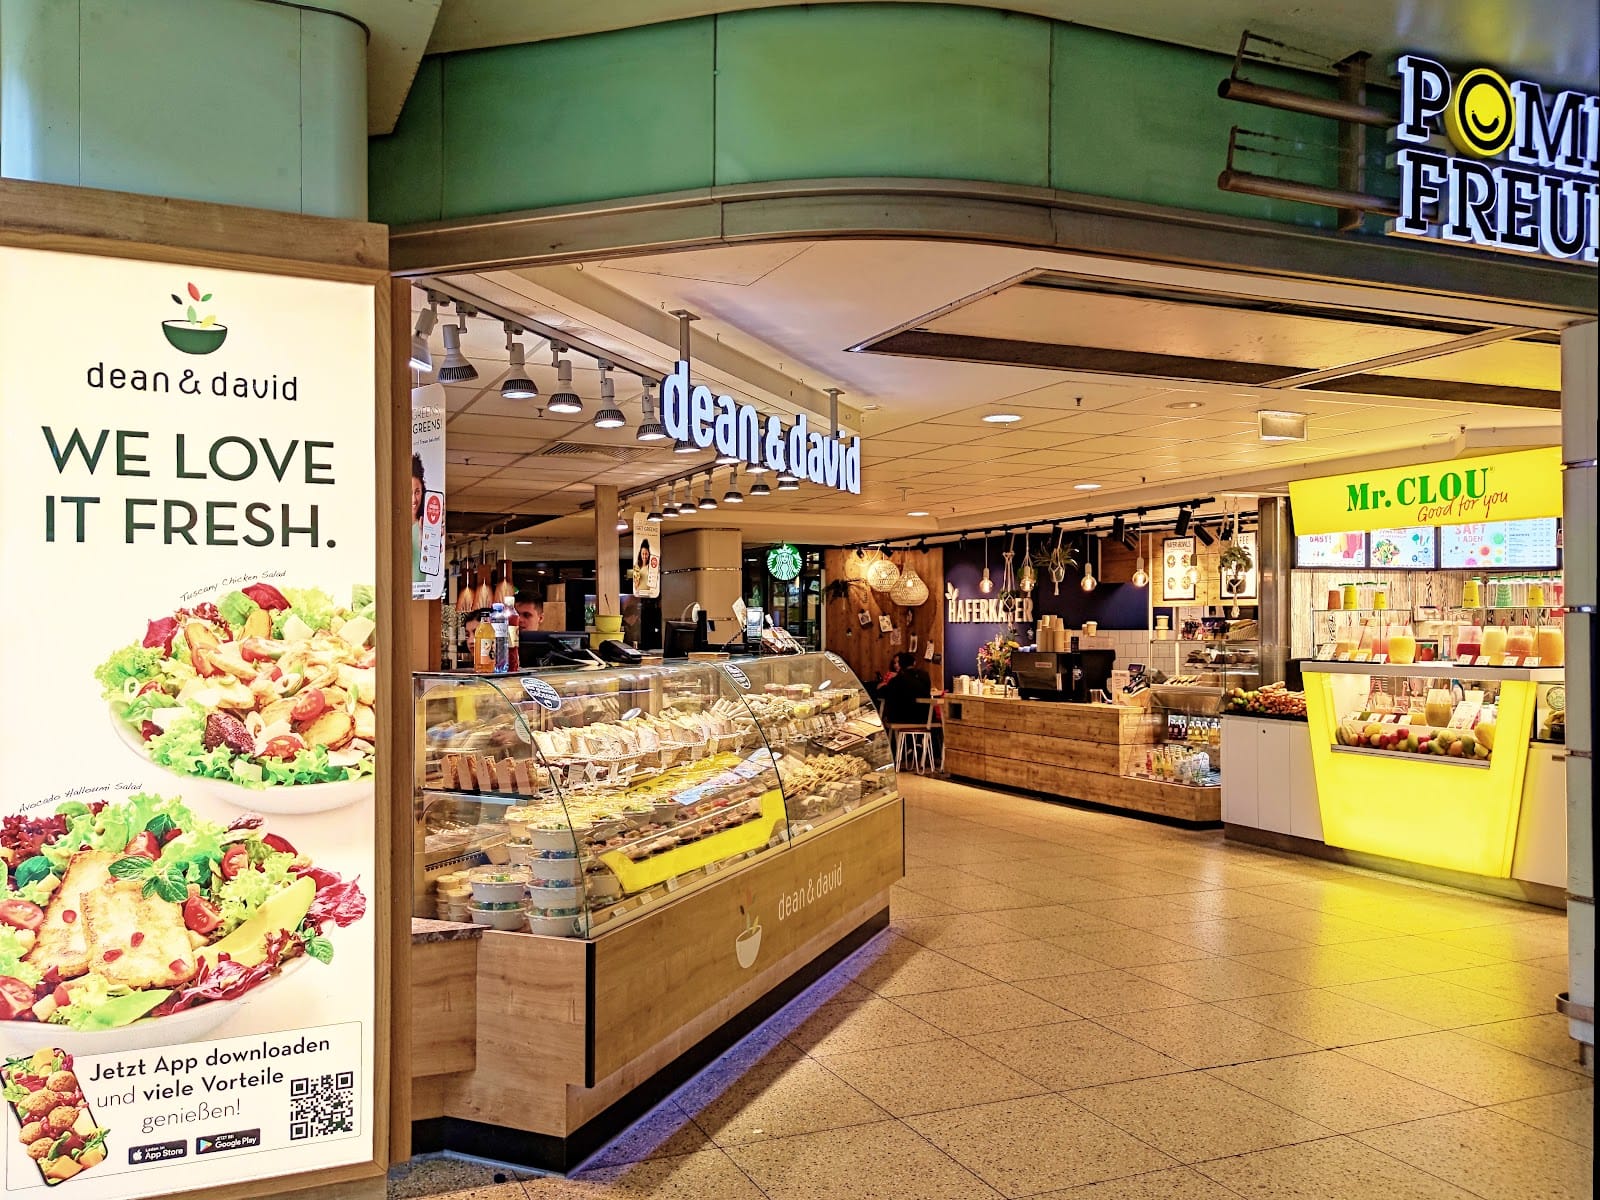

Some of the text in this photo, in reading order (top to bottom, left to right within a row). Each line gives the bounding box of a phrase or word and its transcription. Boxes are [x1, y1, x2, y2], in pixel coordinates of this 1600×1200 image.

[1397, 55, 1598, 175] POM
[1395, 149, 1598, 262] FREU
[87, 362, 297, 401] dean & david
[660, 360, 861, 495] dean & david
[41, 425, 336, 485] WE LOVE
[1346, 467, 1489, 511] Mr. CLOU
[1417, 490, 1508, 522] Good for you
[45, 495, 337, 548] IT FRESH.
[180, 569, 287, 602] Tuscany Chicken Salad
[948, 598, 1034, 623] HAFERKAER
[19, 782, 143, 812] Avocado Halloumi Salad
[778, 860, 842, 921] dean & david
[89, 1036, 330, 1081] Jetzt App downloaden
[97, 1067, 284, 1108] und viele Vorteile
[141, 1098, 241, 1134] genießen!
[145, 1148, 184, 1160] App Store
[215, 1136, 257, 1149] Google Play
